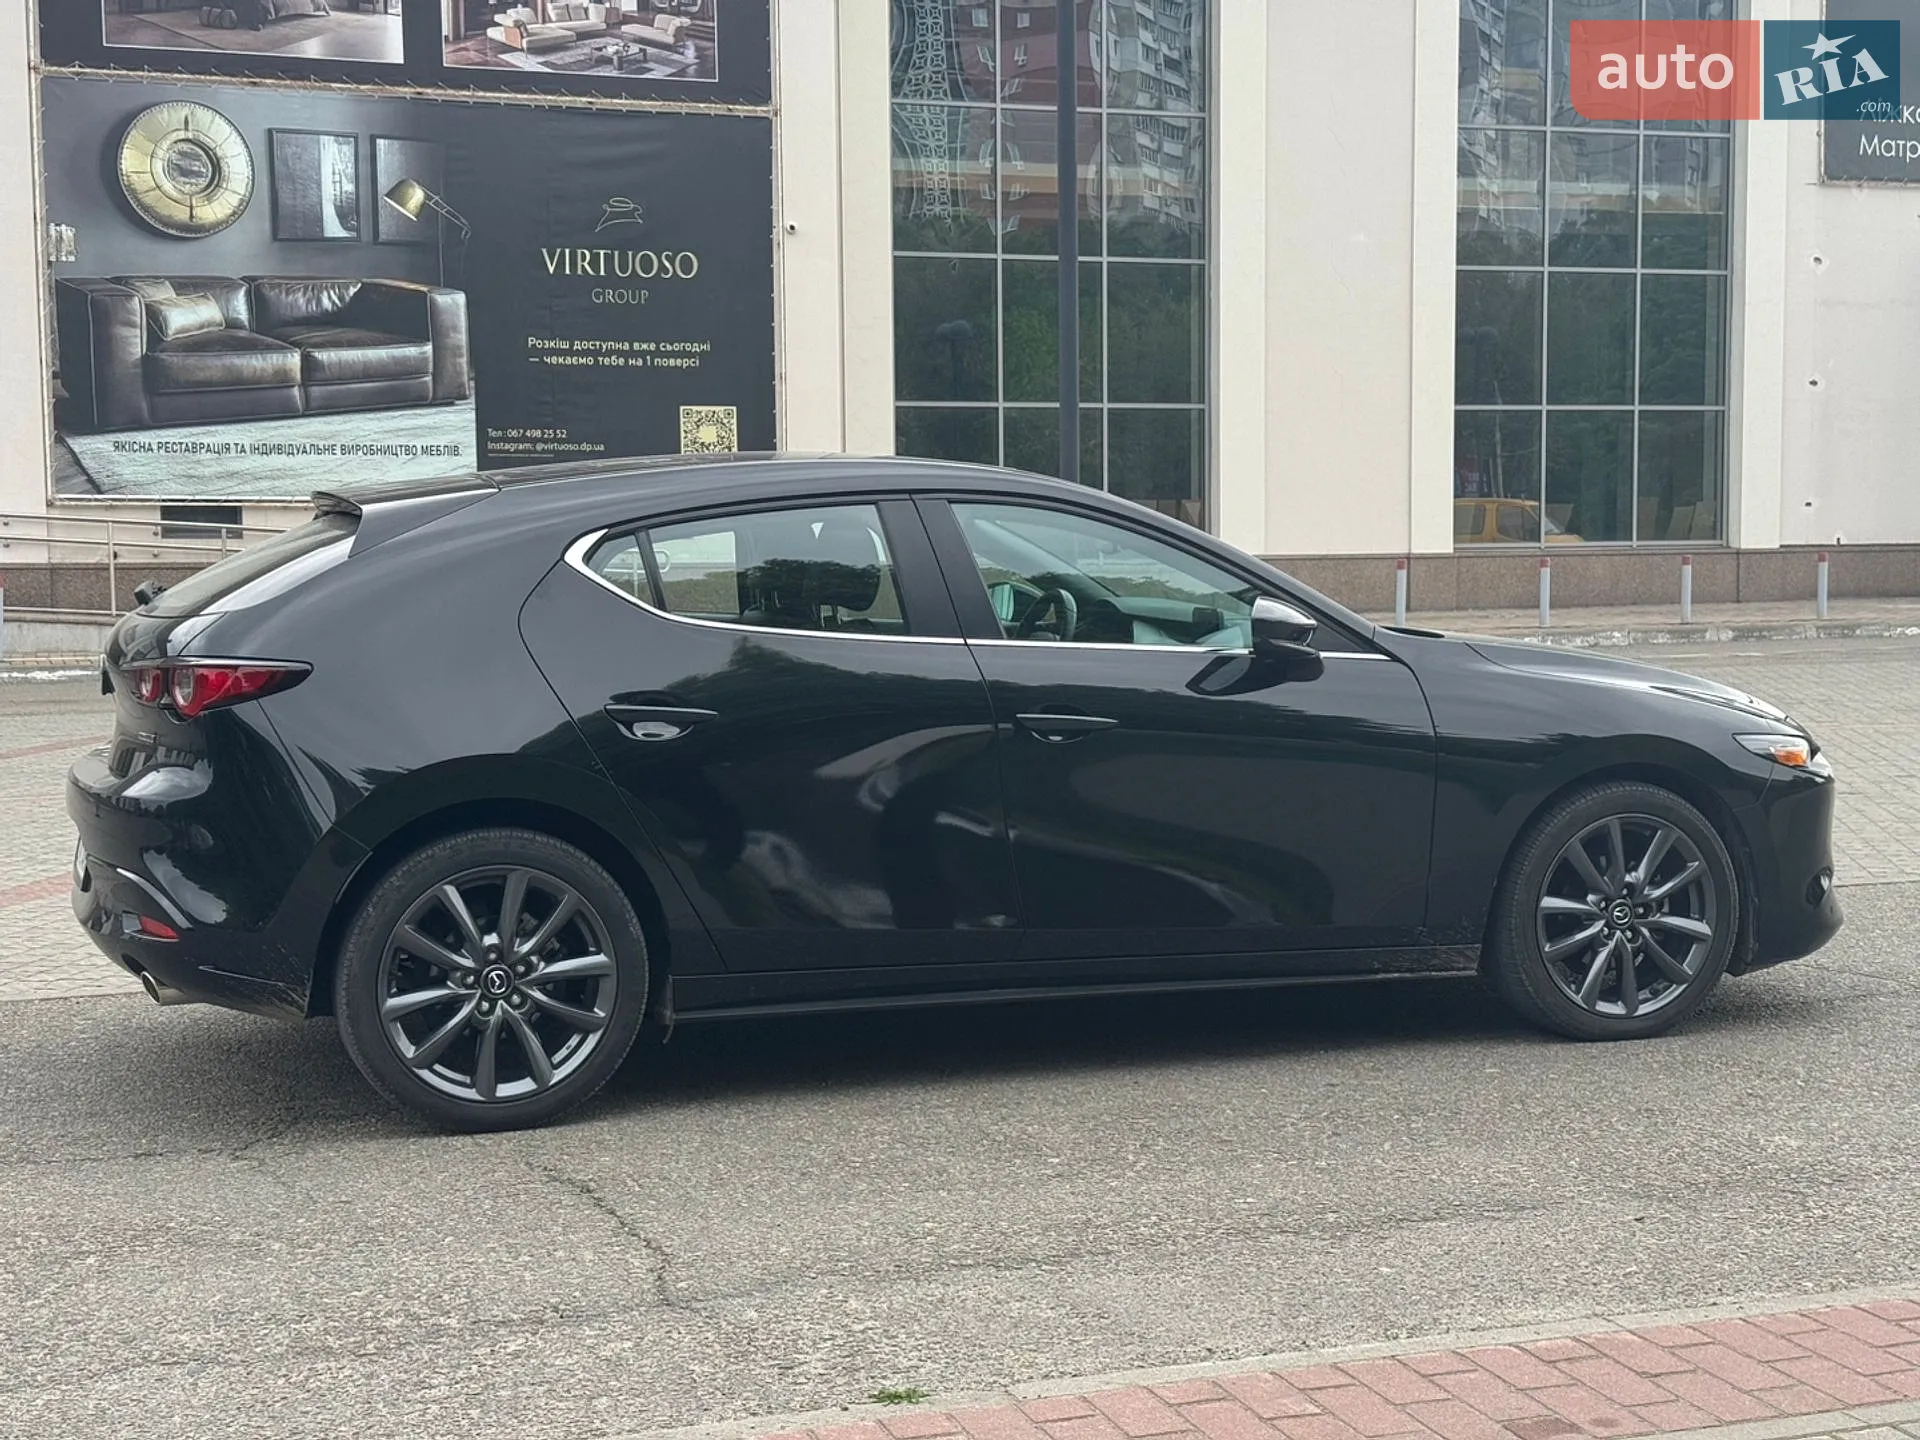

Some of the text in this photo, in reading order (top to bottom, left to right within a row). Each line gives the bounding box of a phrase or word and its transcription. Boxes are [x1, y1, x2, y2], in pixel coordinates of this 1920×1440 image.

[541, 247, 699, 279] VIRTUOSO
[591, 288, 649, 304] GROUP
[527, 336, 711, 353] Розкіш доступна вже сьогодні
[543, 355, 594, 366] чекаємо
[597, 355, 625, 367] тебе
[628, 356, 643, 367] на
[654, 356, 700, 369] поверсі
[525, 429, 542, 438] 498
[543, 429, 554, 438] 25
[555, 429, 567, 438] 52
[113, 440, 462, 458] ЯКІСНА РЕСТАВРАЦІЯ ТА ІНДИВІДУАЛЬНЕ ВИРОБНИЦТВО МЕБЛІВ.
[487, 441, 605, 453] Instagram: @virtuoso.dp.ua
